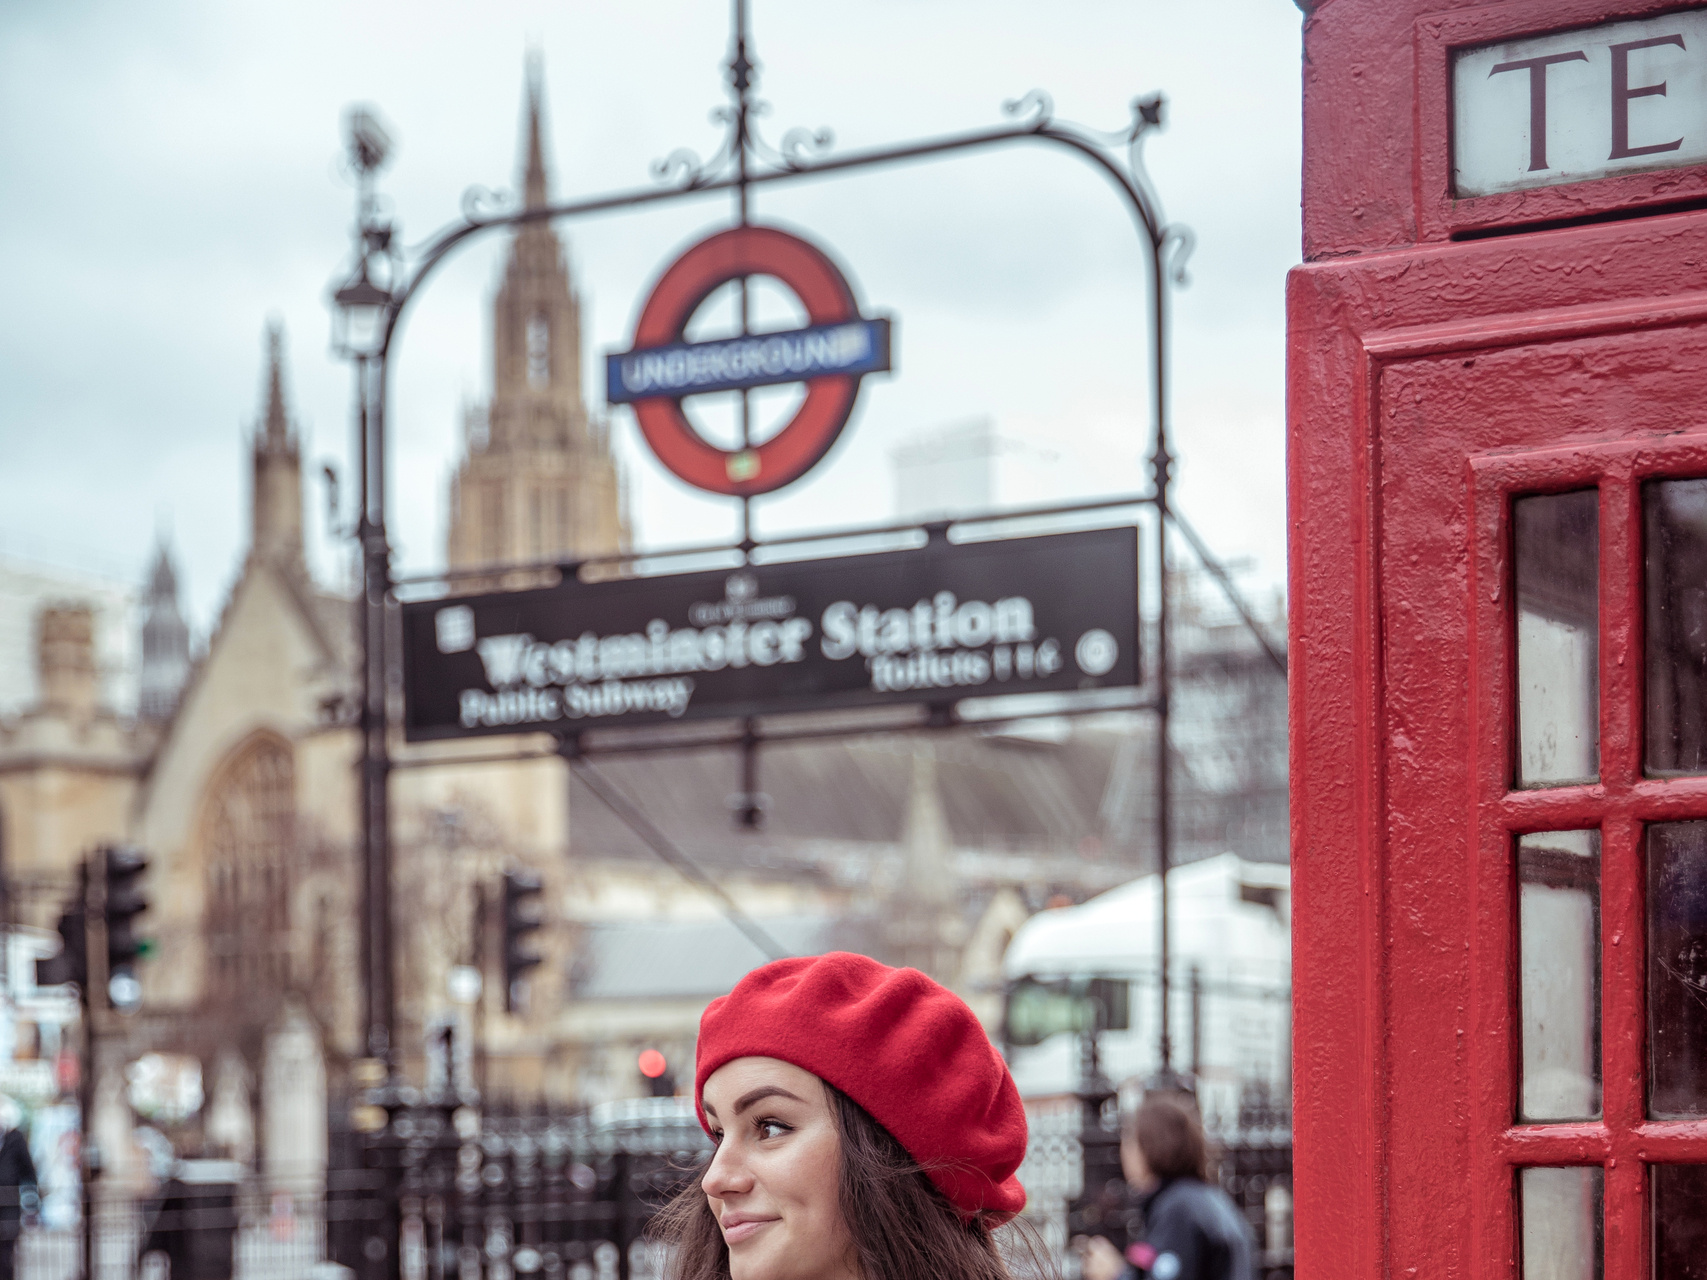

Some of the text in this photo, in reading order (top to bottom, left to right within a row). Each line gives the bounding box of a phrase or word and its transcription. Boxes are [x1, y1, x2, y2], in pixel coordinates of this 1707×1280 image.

[1487, 34, 1686, 172] TE
[621, 324, 871, 393] UNDERGROUND
[477, 617, 813, 690] Westminster
[821, 591, 1035, 660] Station
[460, 676, 694, 727] Public Subway
